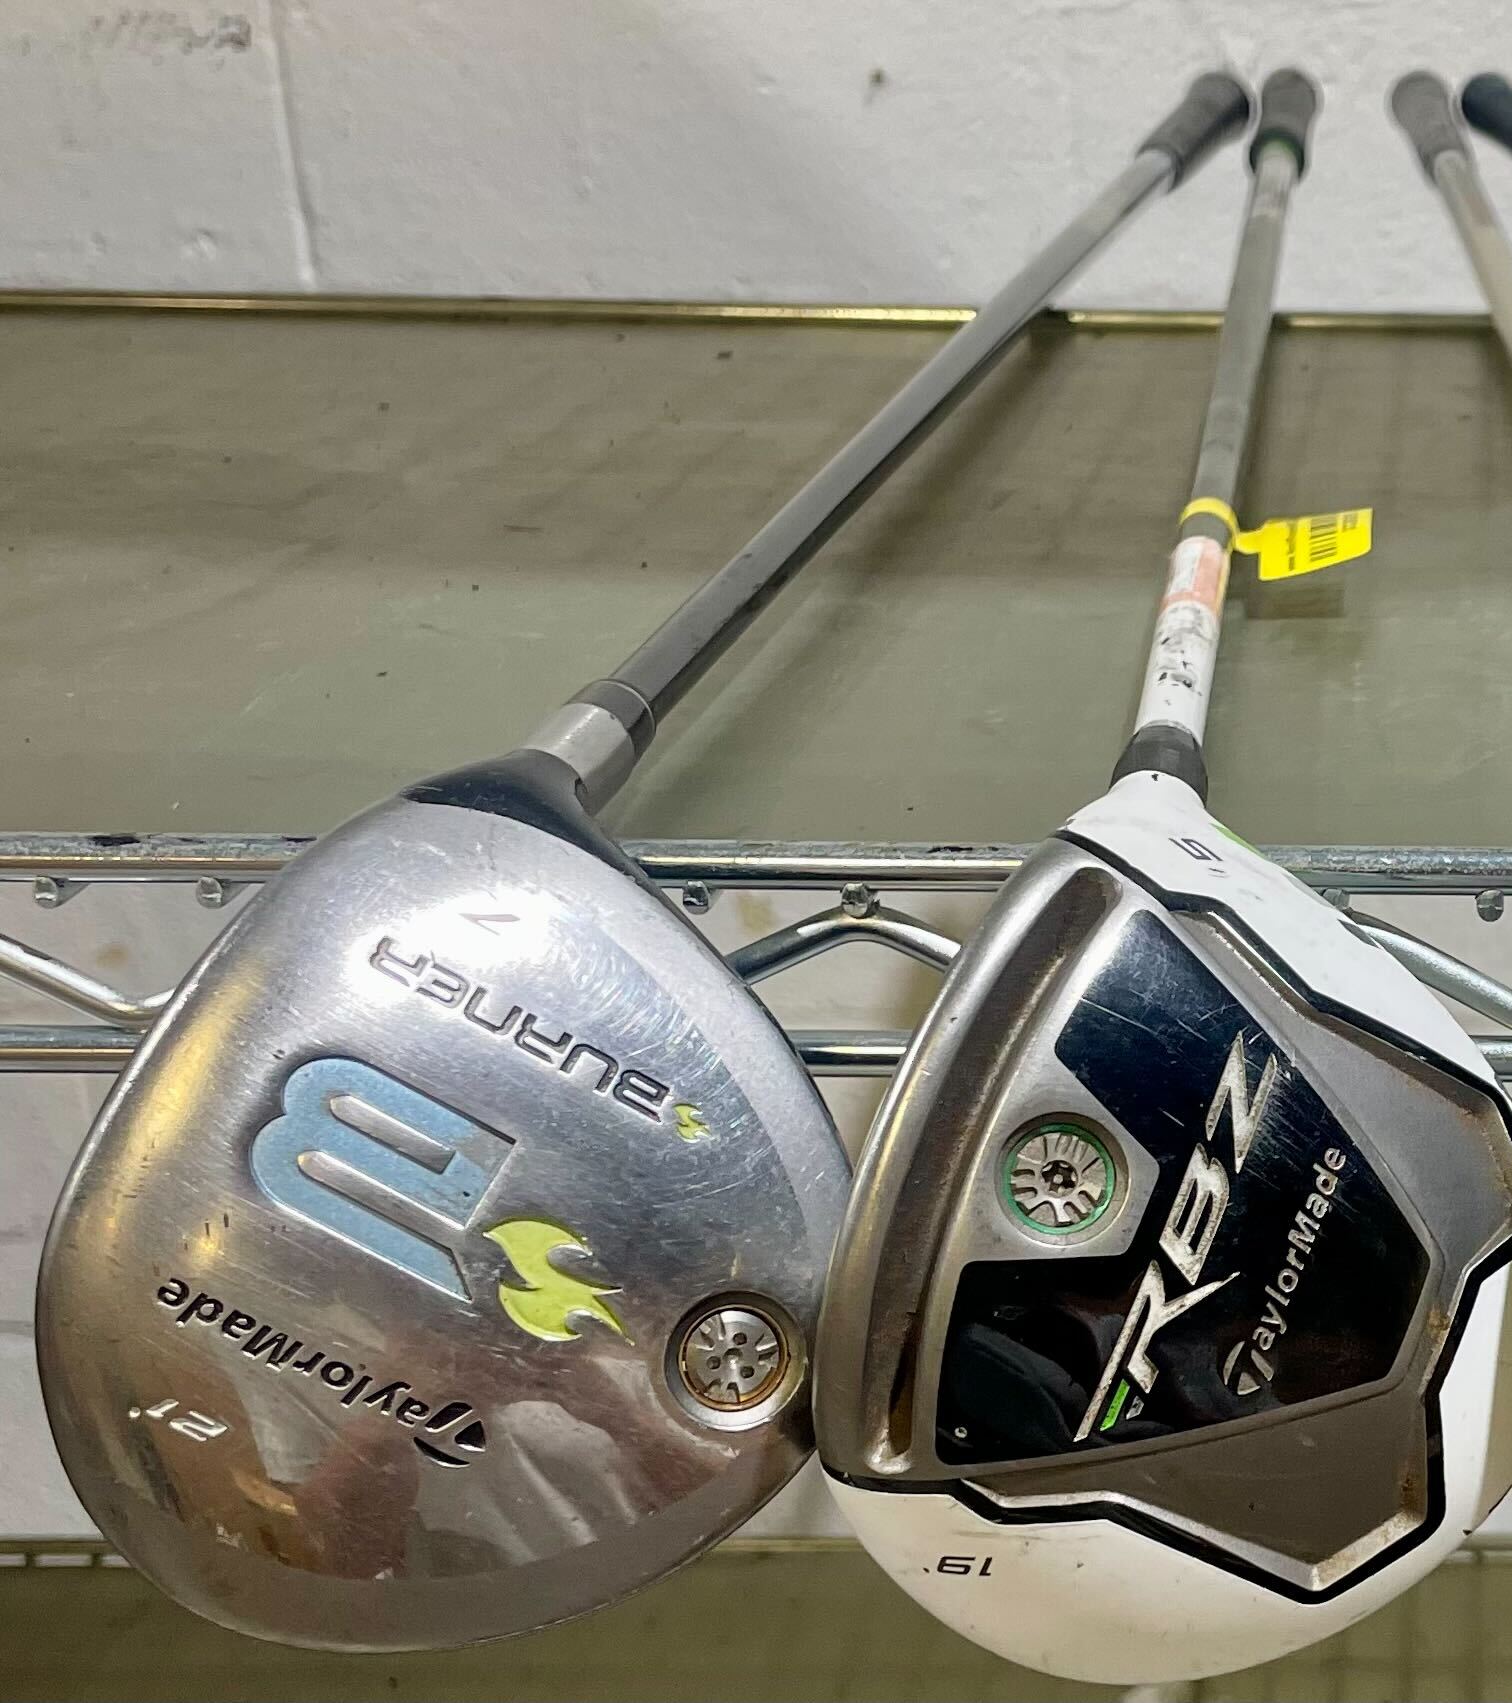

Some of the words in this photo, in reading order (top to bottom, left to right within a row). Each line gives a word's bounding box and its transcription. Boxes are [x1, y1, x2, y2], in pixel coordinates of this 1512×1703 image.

[458, 912, 521, 936] 7
[1168, 838, 1223, 861] 5
[368, 934, 675, 1124] BURNER
[1073, 1030, 1278, 1442] RBZ
[1222, 1145, 1347, 1396] TaylorMade
[157, 1278, 486, 1468] TaylorMade
